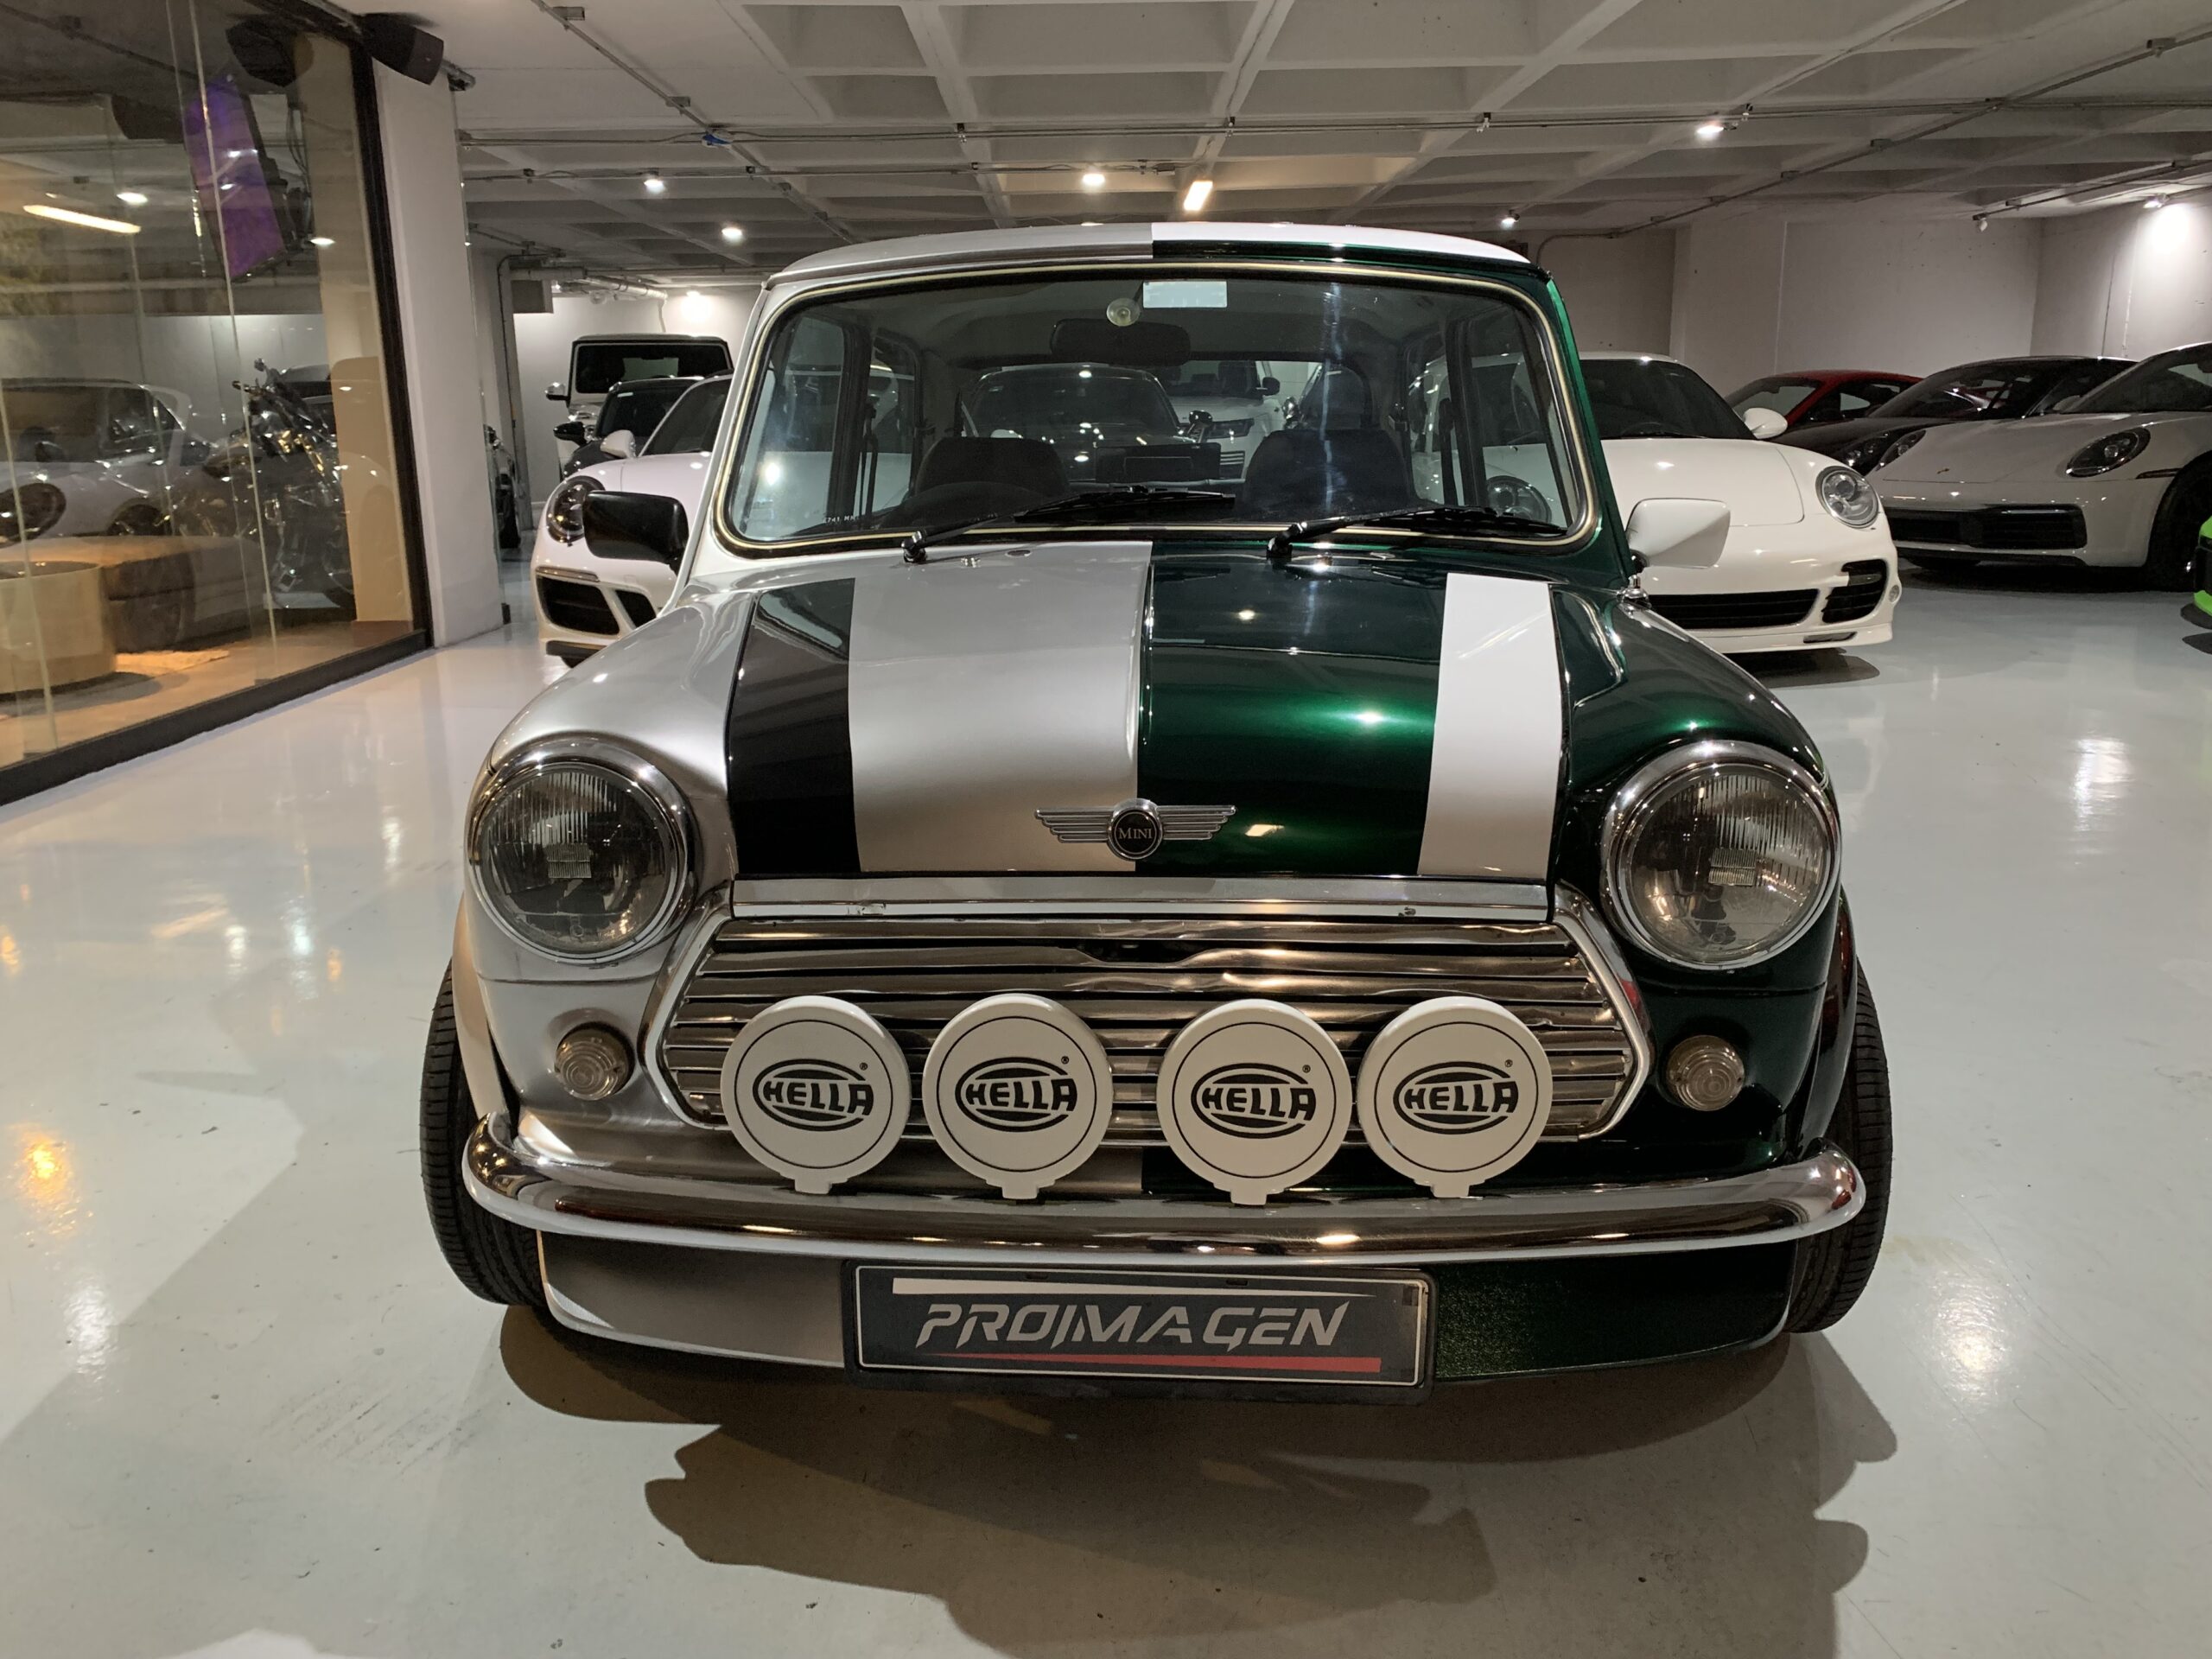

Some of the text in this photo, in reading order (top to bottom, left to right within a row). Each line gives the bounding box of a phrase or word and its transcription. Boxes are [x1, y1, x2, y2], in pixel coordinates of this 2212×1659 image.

[1117, 827, 1153, 839] MINI
[762, 1080, 874, 1116] HELLA
[965, 1078, 1078, 1112] HELLA
[1201, 1087, 1317, 1122] HELLA
[1403, 1081, 1519, 1113] HELLA
[916, 1300, 1350, 1352] PROIMAGEN
